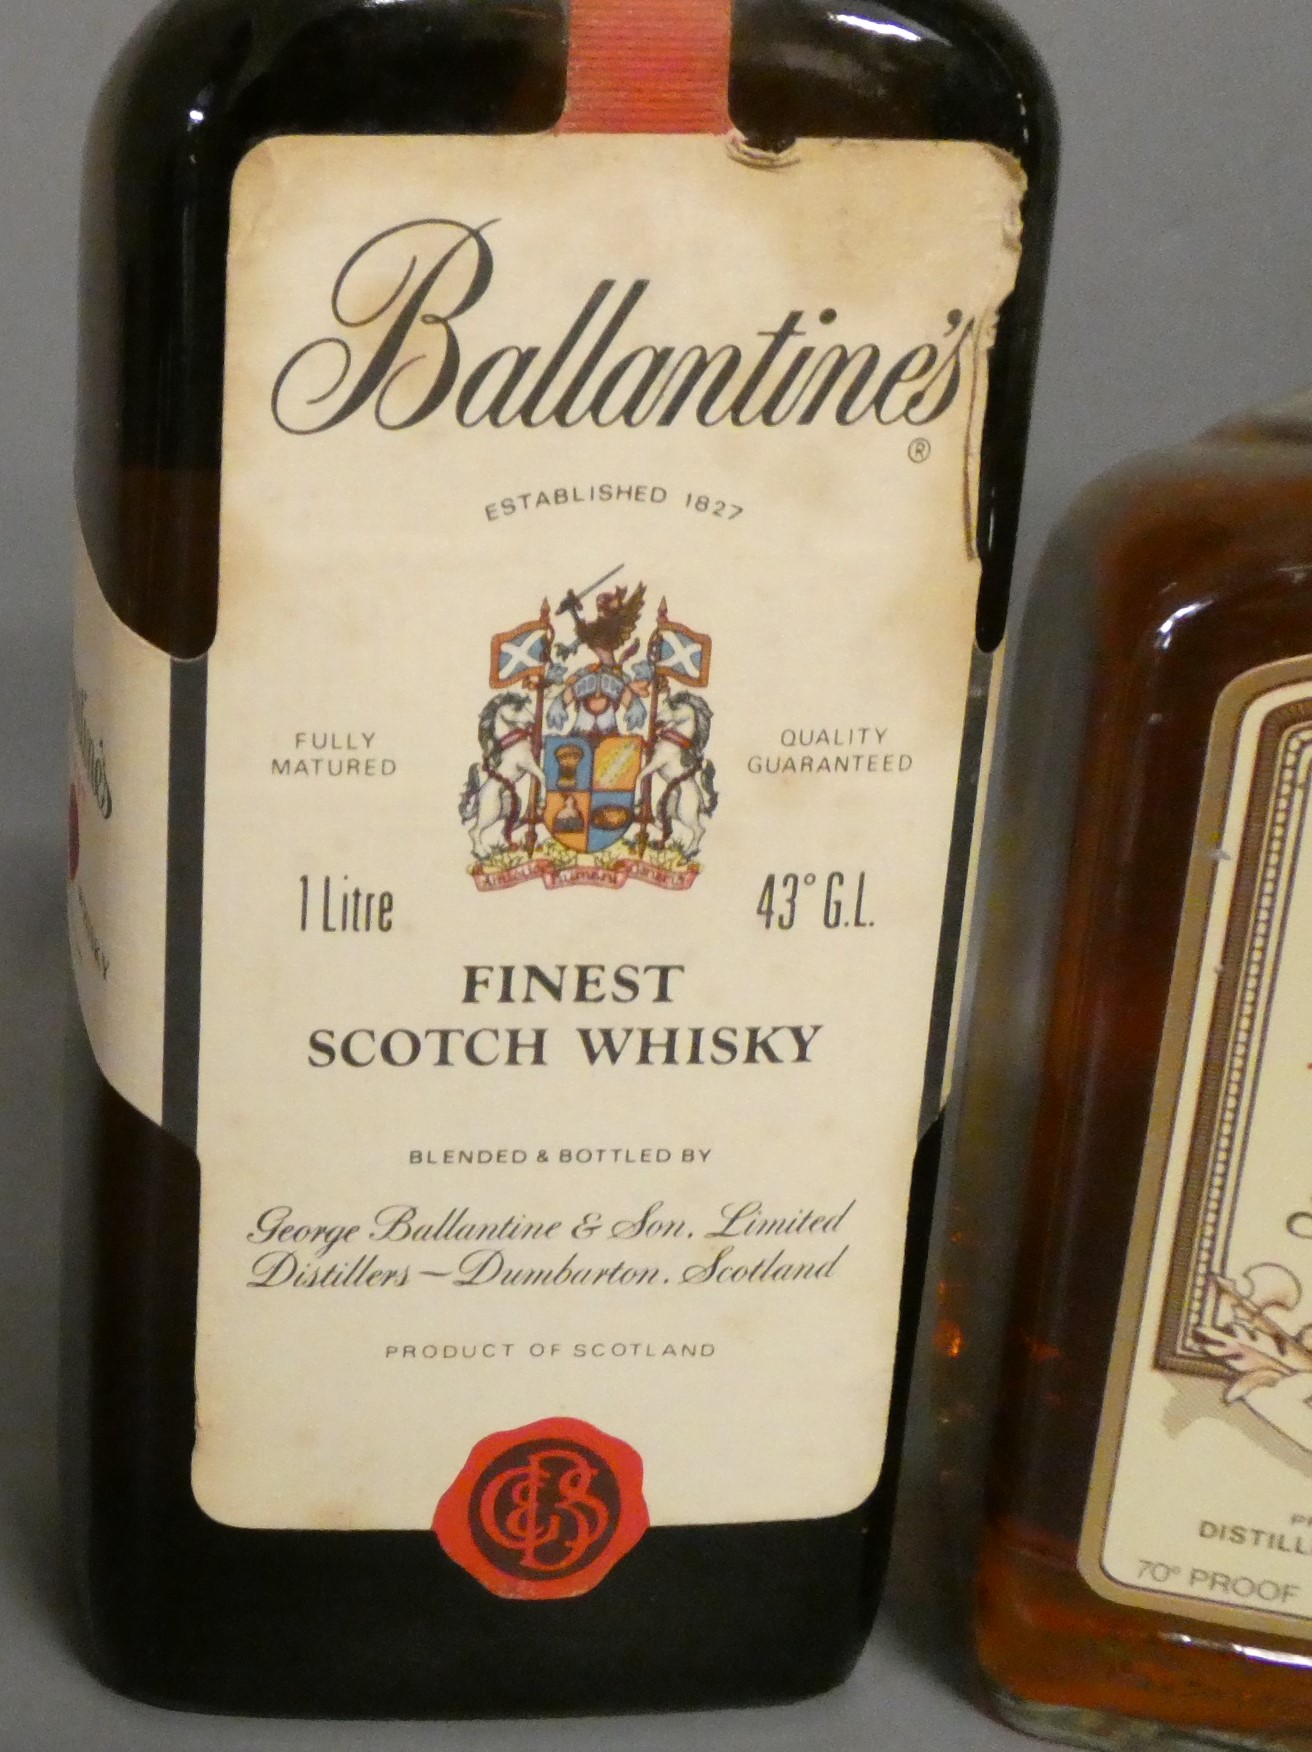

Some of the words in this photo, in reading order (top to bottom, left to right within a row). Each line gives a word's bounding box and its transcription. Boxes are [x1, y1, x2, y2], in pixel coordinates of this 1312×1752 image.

[270, 217, 974, 435] Ballantine's
[484, 484, 668, 522] ESTABLISHED
[684, 492, 744, 521] 1827
[295, 731, 376, 751] FULLY
[780, 727, 888, 748] QUALITY
[271, 757, 397, 777] MATURED
[747, 753, 914, 774] GUARANTEED
[298, 874, 309, 932] 1
[322, 874, 394, 933] Litre
[756, 872, 816, 931] 43°
[823, 871, 876, 929] G.L.
[461, 964, 686, 1004] FINEST
[307, 1028, 548, 1068] SCOTCH
[577, 1024, 823, 1066] WHISKY
[409, 1149, 527, 1165] BLENDED
[536, 1149, 550, 1164] &
[559, 1148, 672, 1164] BOTTLED
[681, 1147, 712, 1163] BY
[246, 1205, 361, 1258] George
[368, 1204, 562, 1242] Ballantine
[571, 1211, 603, 1240] &
[703, 1198, 857, 1239] Limited
[678, 1244, 850, 1286] Scotland
[385, 1345, 515, 1360] PRODUCT
[529, 1344, 562, 1358] OF
[573, 1342, 717, 1358] SCOTLAND
[1188, 1566, 1302, 1604] PROOF
